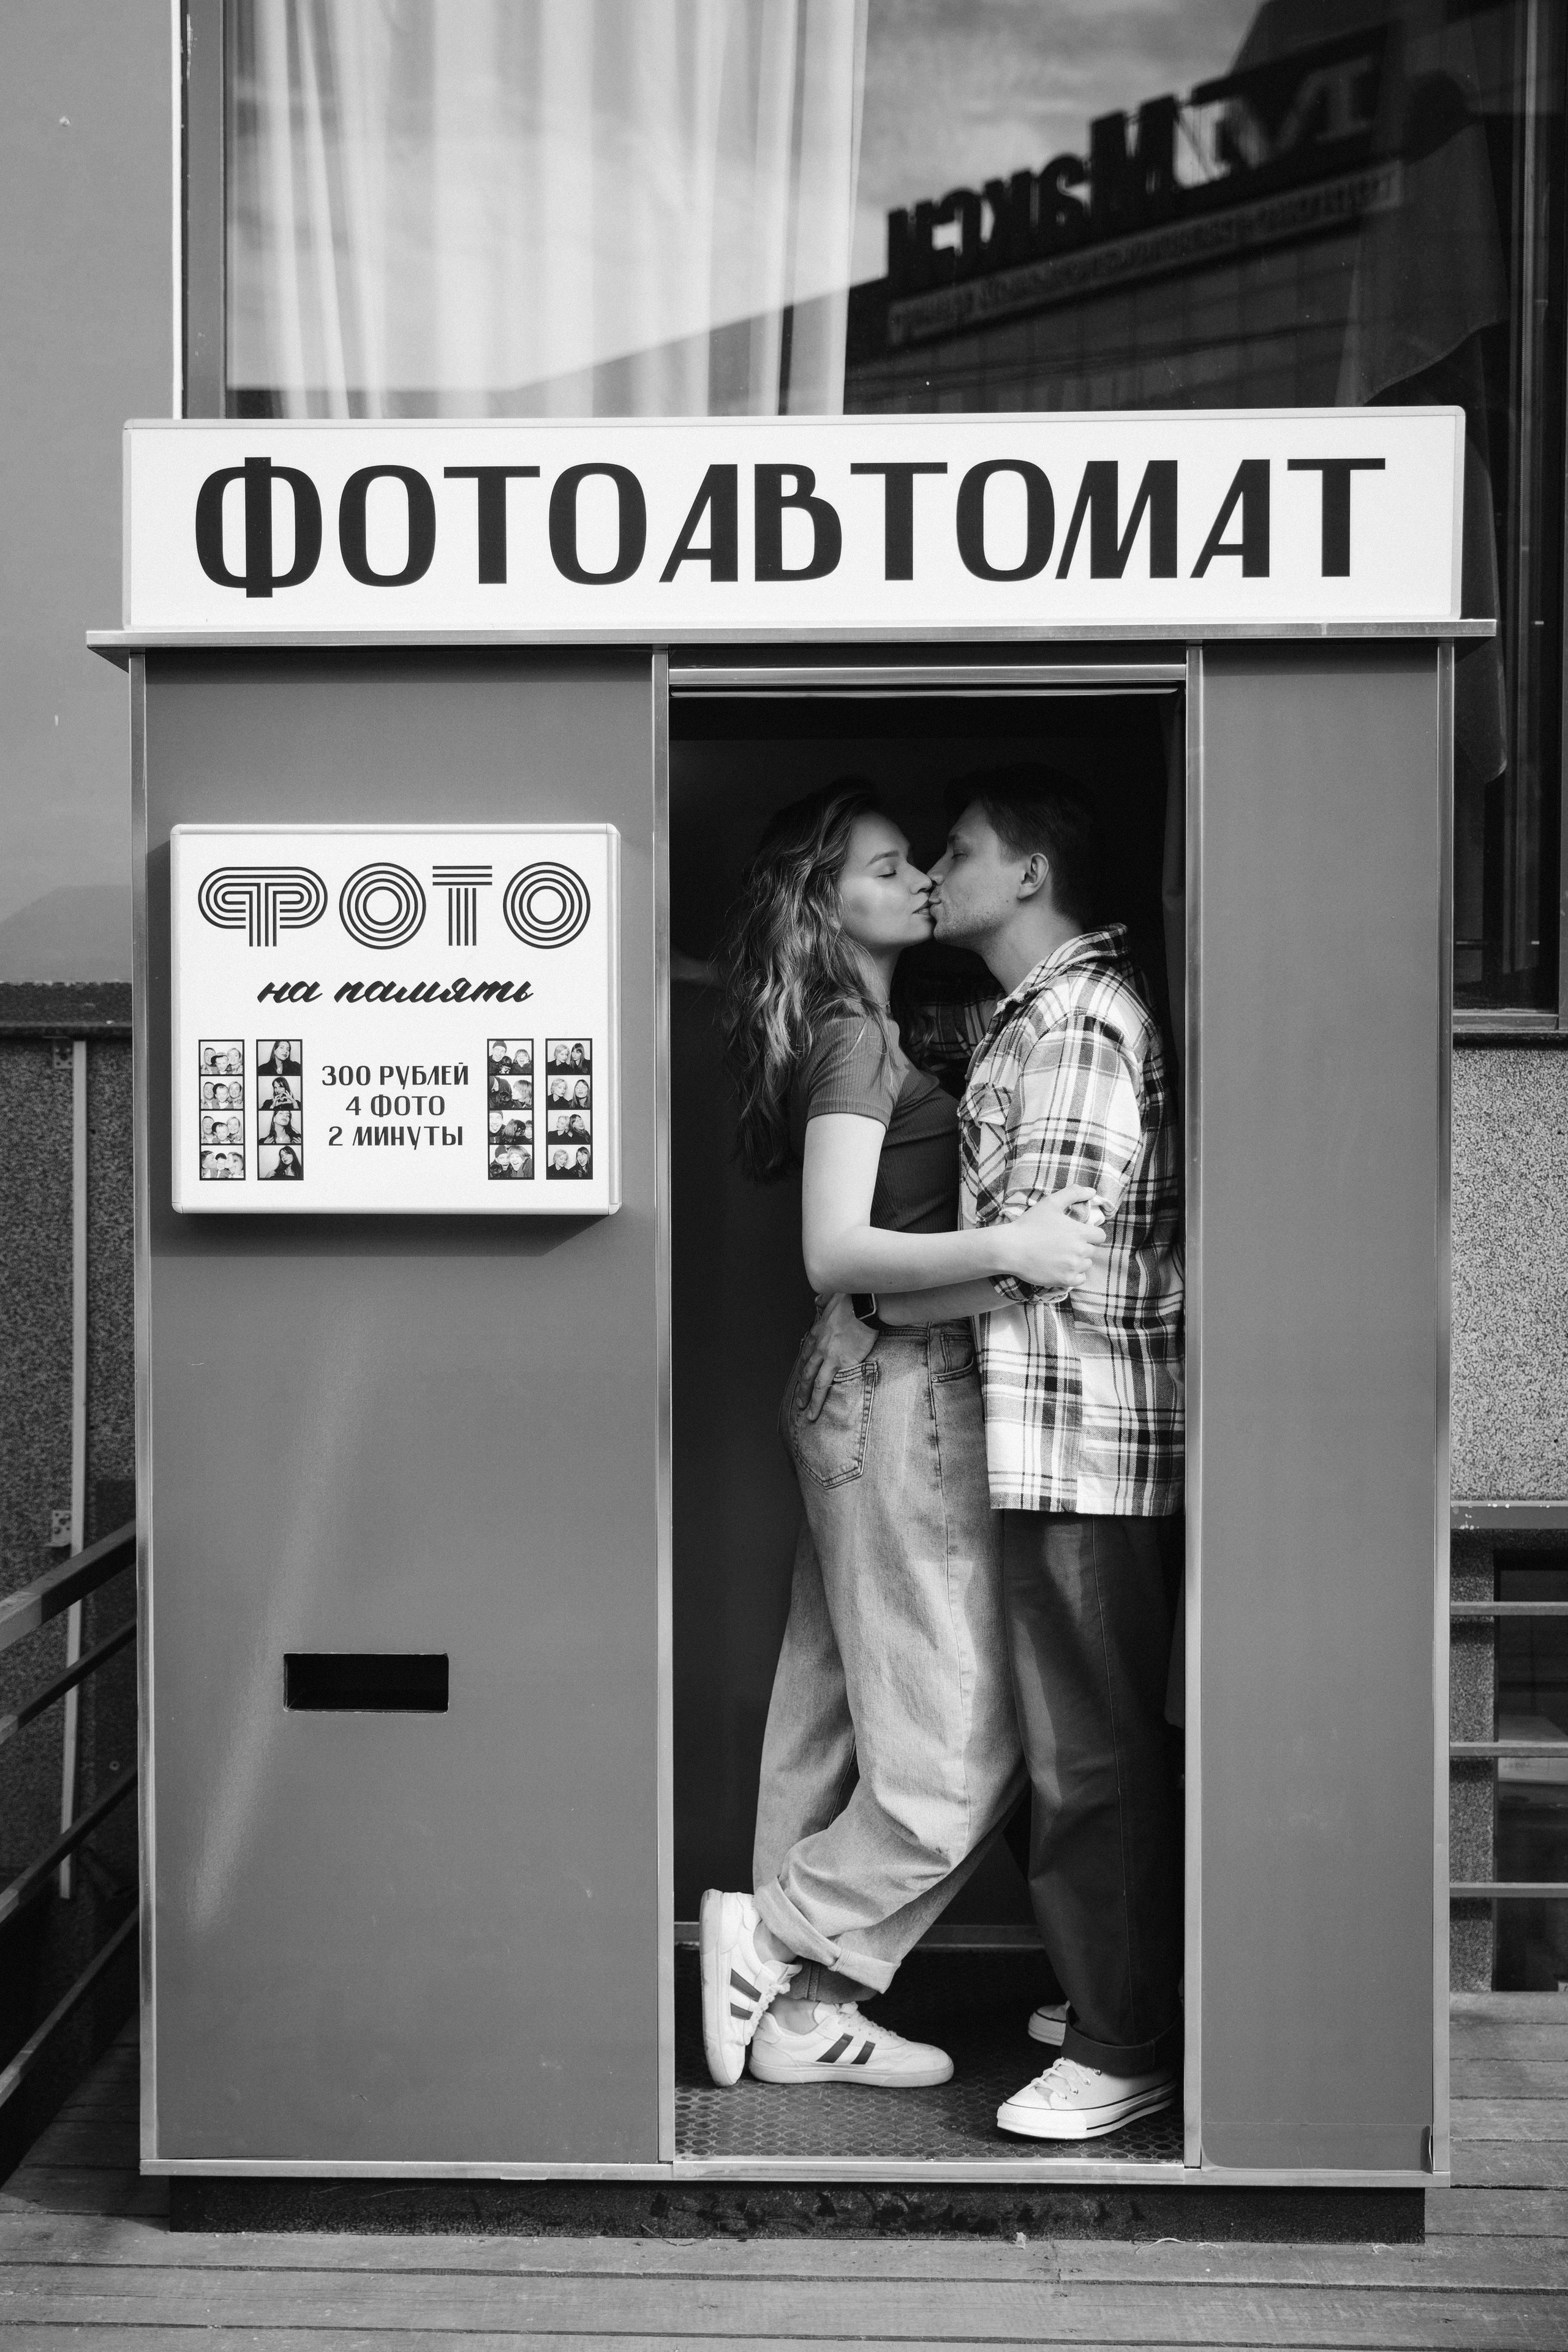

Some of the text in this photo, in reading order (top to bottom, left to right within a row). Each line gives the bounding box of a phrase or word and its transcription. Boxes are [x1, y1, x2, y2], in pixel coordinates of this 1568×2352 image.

[195, 456, 1386, 598] ФОТОАВТОМАТ
[197, 861, 591, 950] ФОТО
[257, 977, 533, 1003] на память
[322, 1062, 469, 1088] 300 РУБЛЕЙ
[345, 1094, 445, 1118] 4 ФОТО
[328, 1126, 462, 1150] 2 МИНУТЫ
